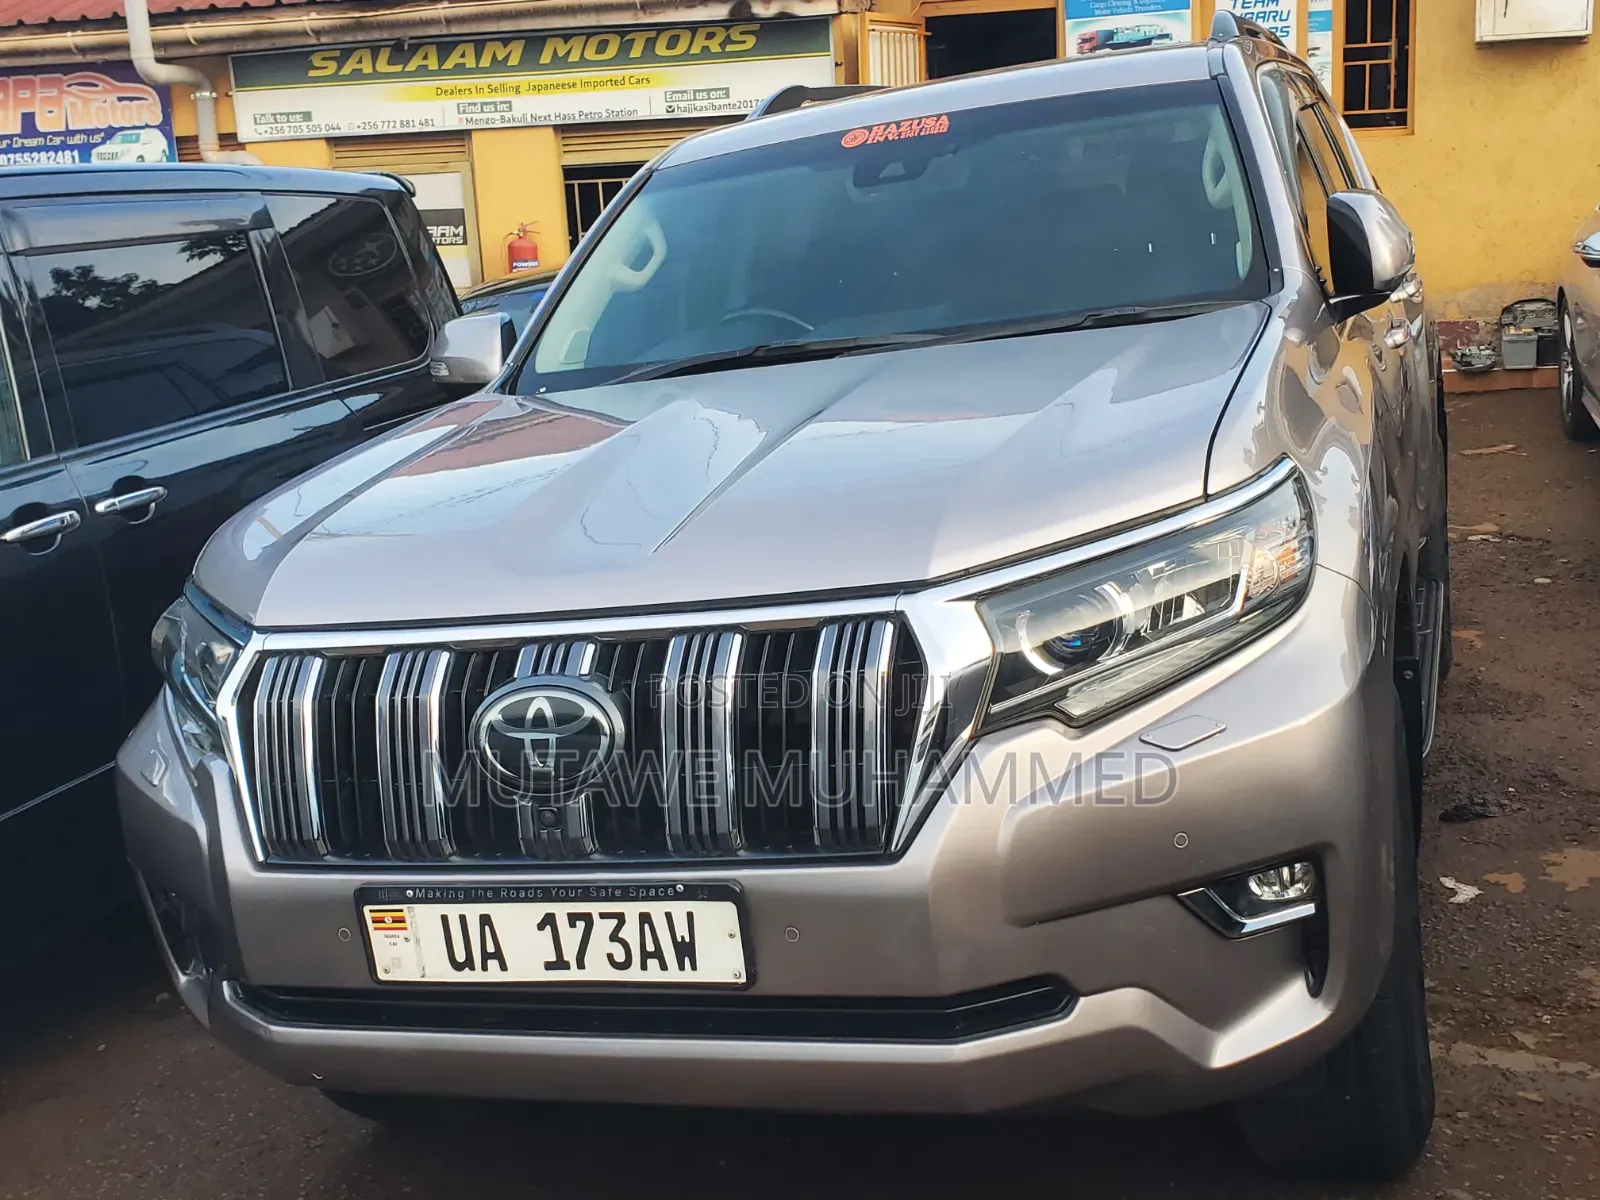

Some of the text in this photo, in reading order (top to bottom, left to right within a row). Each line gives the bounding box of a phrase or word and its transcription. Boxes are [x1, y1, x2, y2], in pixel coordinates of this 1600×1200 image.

[1240, 9, 1291, 22] BARU
[307, 24, 761, 77] SALAAM MOTORS
[436, 75, 651, 96] Dealers In Selling Japaneese Imported Cars
[665, 89, 726, 102] Email us on:
[459, 102, 481, 113] Find
[483, 104, 495, 112] us
[676, 98, 764, 114] hajjkasibante2017
[254, 114, 276, 124] Talk
[277, 114, 287, 123] to
[530, 112, 552, 122] Next
[554, 108, 576, 121] Hass
[578, 107, 603, 120] Petro
[605, 106, 639, 118] Station
[264, 118, 435, 135] +256 705 505 044 +256 772 881 481
[46, 134, 64, 145] Car
[415, 886, 675, 900] Making the Roads Your Safe Space
[440, 911, 699, 972] UA 173AW
